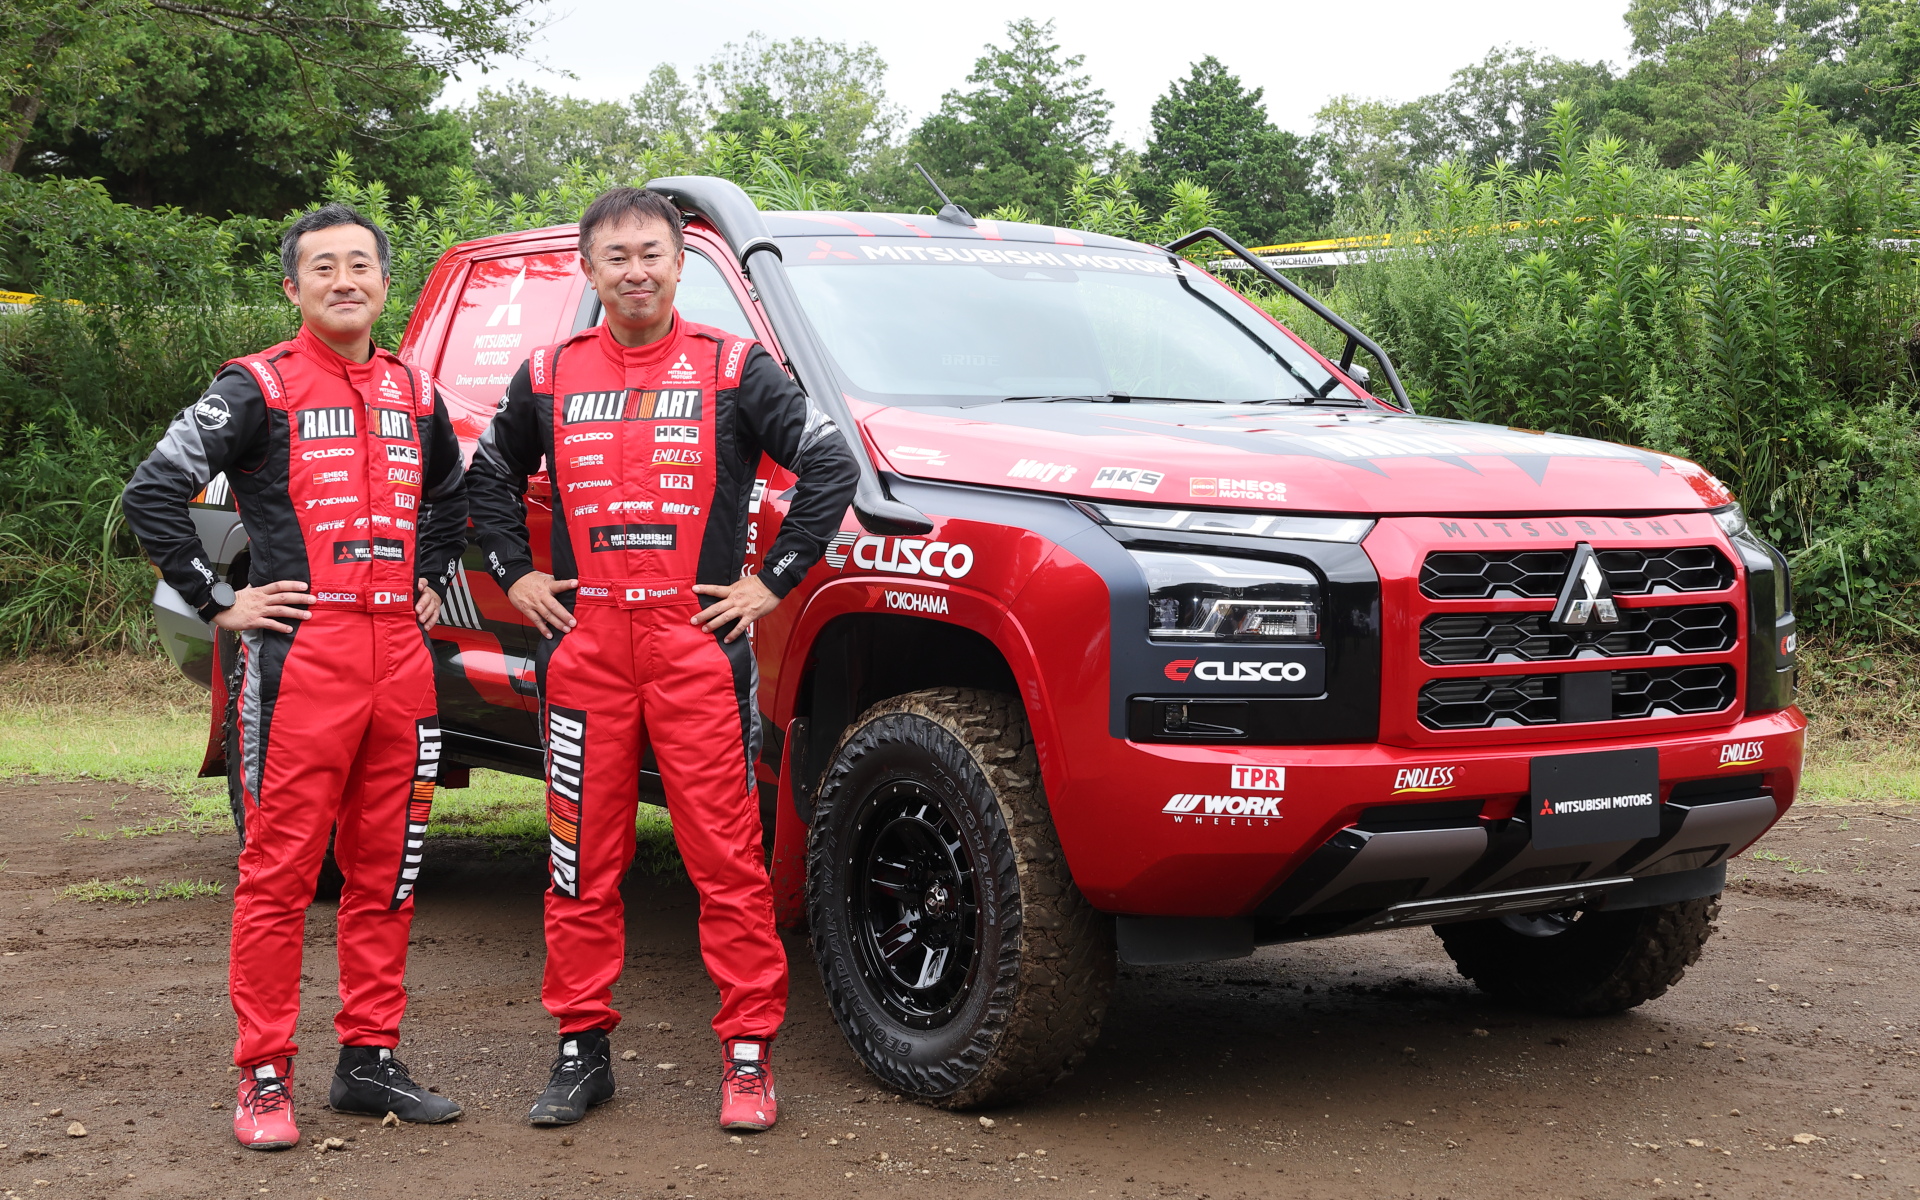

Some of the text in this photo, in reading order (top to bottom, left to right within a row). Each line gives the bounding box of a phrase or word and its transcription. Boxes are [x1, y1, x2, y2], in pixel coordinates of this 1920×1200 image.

[859, 245, 1190, 277] MITSUBISHI MOTORS
[1271, 255, 1324, 267] YOKOHAMA
[473, 333, 522, 349] MITSUBISHI
[474, 350, 511, 366] MOTORS
[725, 341, 747, 379] sparco
[534, 349, 546, 385] sparco
[250, 361, 280, 399] sparco
[455, 373, 473, 386] Drive
[472, 376, 488, 388] your
[656, 427, 699, 438] HKS
[387, 446, 418, 460] HKS
[578, 454, 604, 462] ENEOS
[651, 448, 703, 464] ENDLESS
[323, 470, 348, 479] ENEOS
[387, 467, 422, 485] ENDLESS
[1006, 458, 1078, 483] Moty's
[1097, 469, 1161, 486] HKS
[575, 479, 613, 489] YOKOHAMA
[663, 475, 690, 488] TPR
[1218, 478, 1288, 494] ENEOS
[317, 495, 359, 506] YOKOHAMA
[397, 494, 413, 509] TPR
[1218, 490, 1288, 502] MOTOR OIL
[574, 505, 599, 517] ORTEC
[623, 500, 655, 511] WORK
[661, 501, 702, 516] Moty's
[1438, 518, 1689, 539] MITSUBISHI
[610, 533, 673, 541] MITSUBISHI
[853, 535, 974, 579] CUSCO
[317, 591, 357, 603] sparco
[391, 592, 408, 602] Yasui
[579, 586, 609, 598] sparco
[647, 587, 678, 598] Taguchi
[884, 589, 949, 615] YOKOHAMA
[1194, 660, 1307, 682] CUSCO
[1719, 740, 1765, 764] ENDLESS
[1235, 767, 1280, 789] TPR
[1393, 765, 1456, 790] ENDLESS
[1203, 794, 1284, 816] WORK
[1554, 792, 1653, 814] MITSUBISHI MOTORS
[1173, 815, 1270, 827] WHEELS
